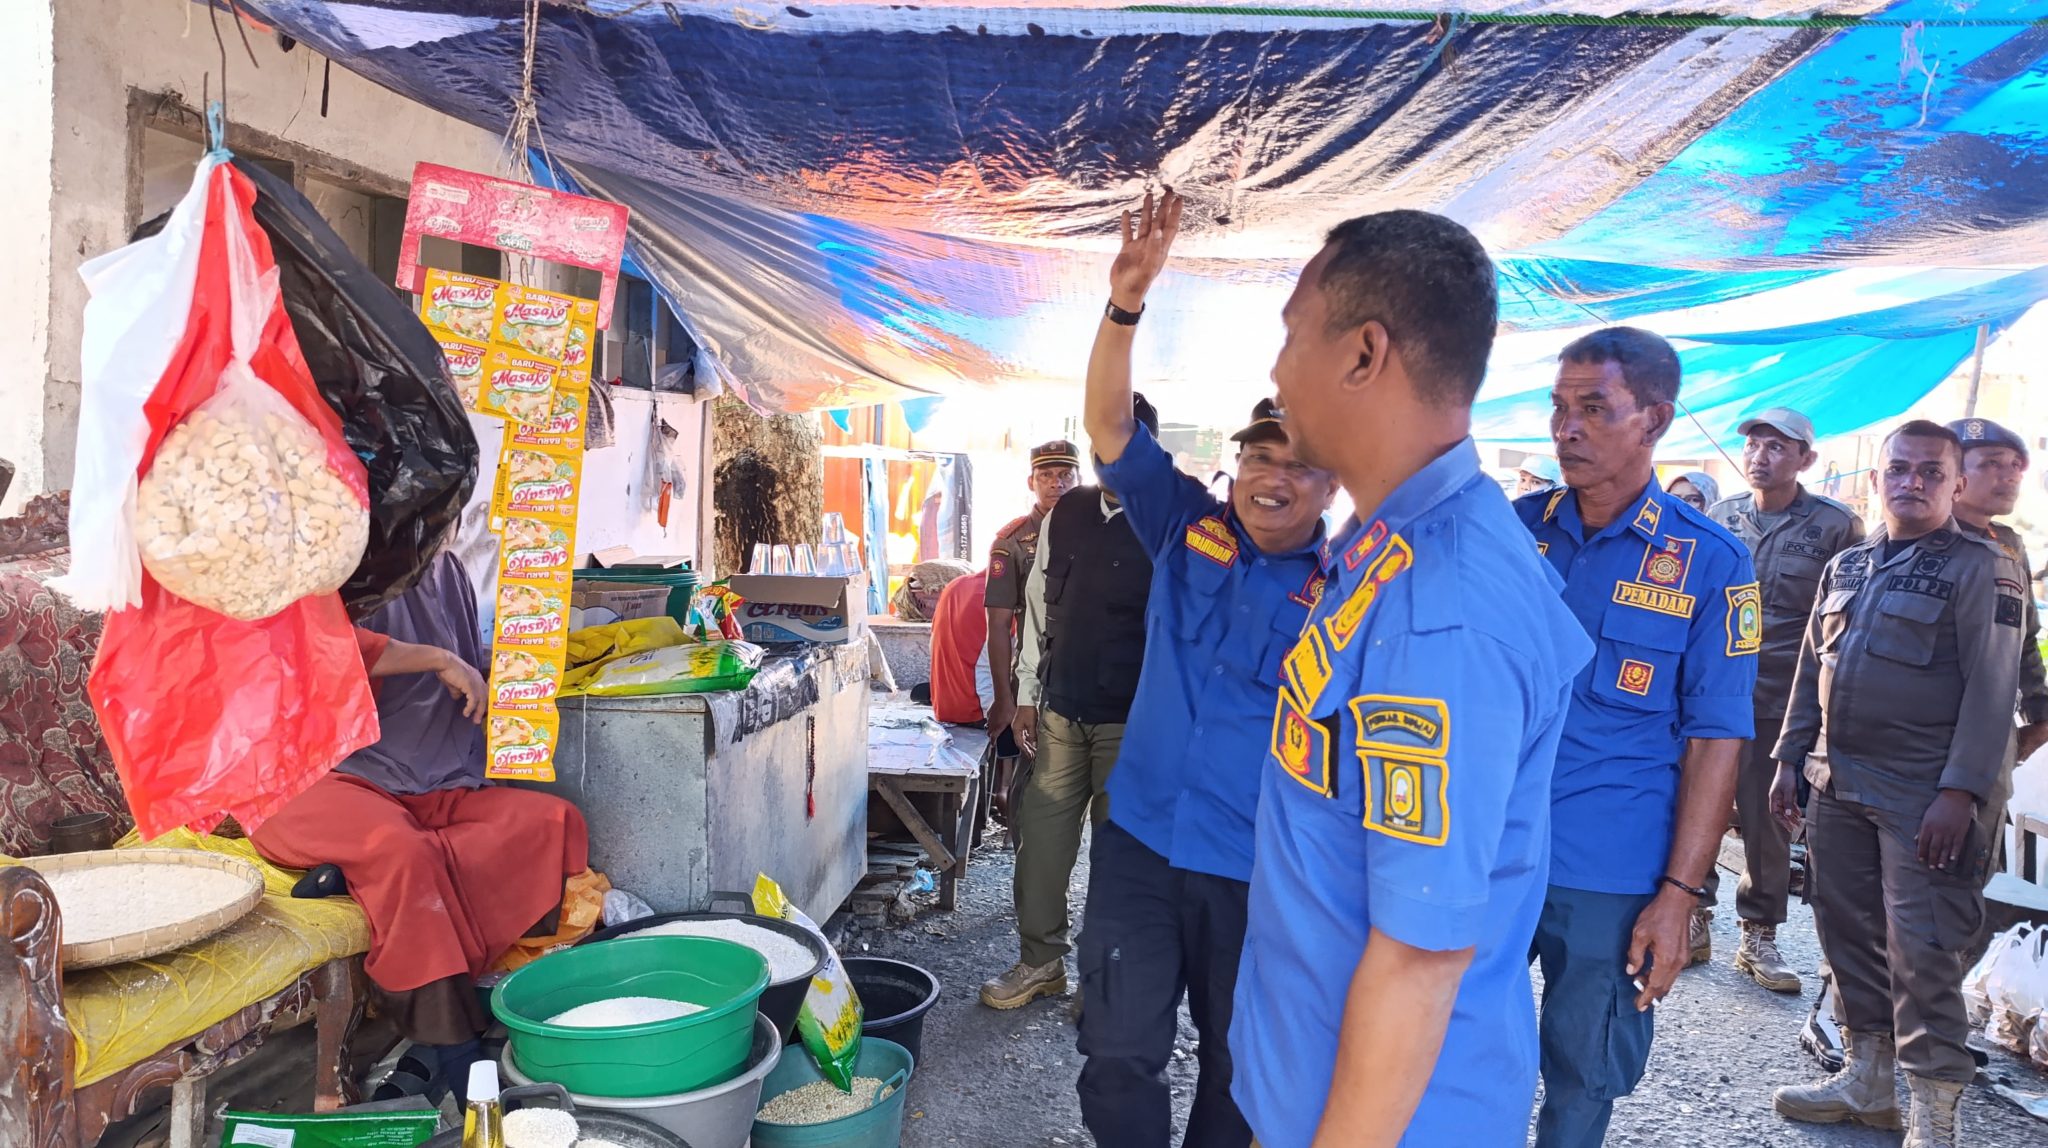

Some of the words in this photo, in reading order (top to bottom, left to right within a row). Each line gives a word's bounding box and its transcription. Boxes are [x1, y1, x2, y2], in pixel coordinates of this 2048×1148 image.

[511, 359, 535, 368] BARU
[1786, 542, 1806, 552] POL
[1812, 547, 1827, 557] PP
[1895, 576, 1921, 590] POL
[1926, 581, 1949, 596] PP
[1618, 585, 1691, 614] PEMADAM
